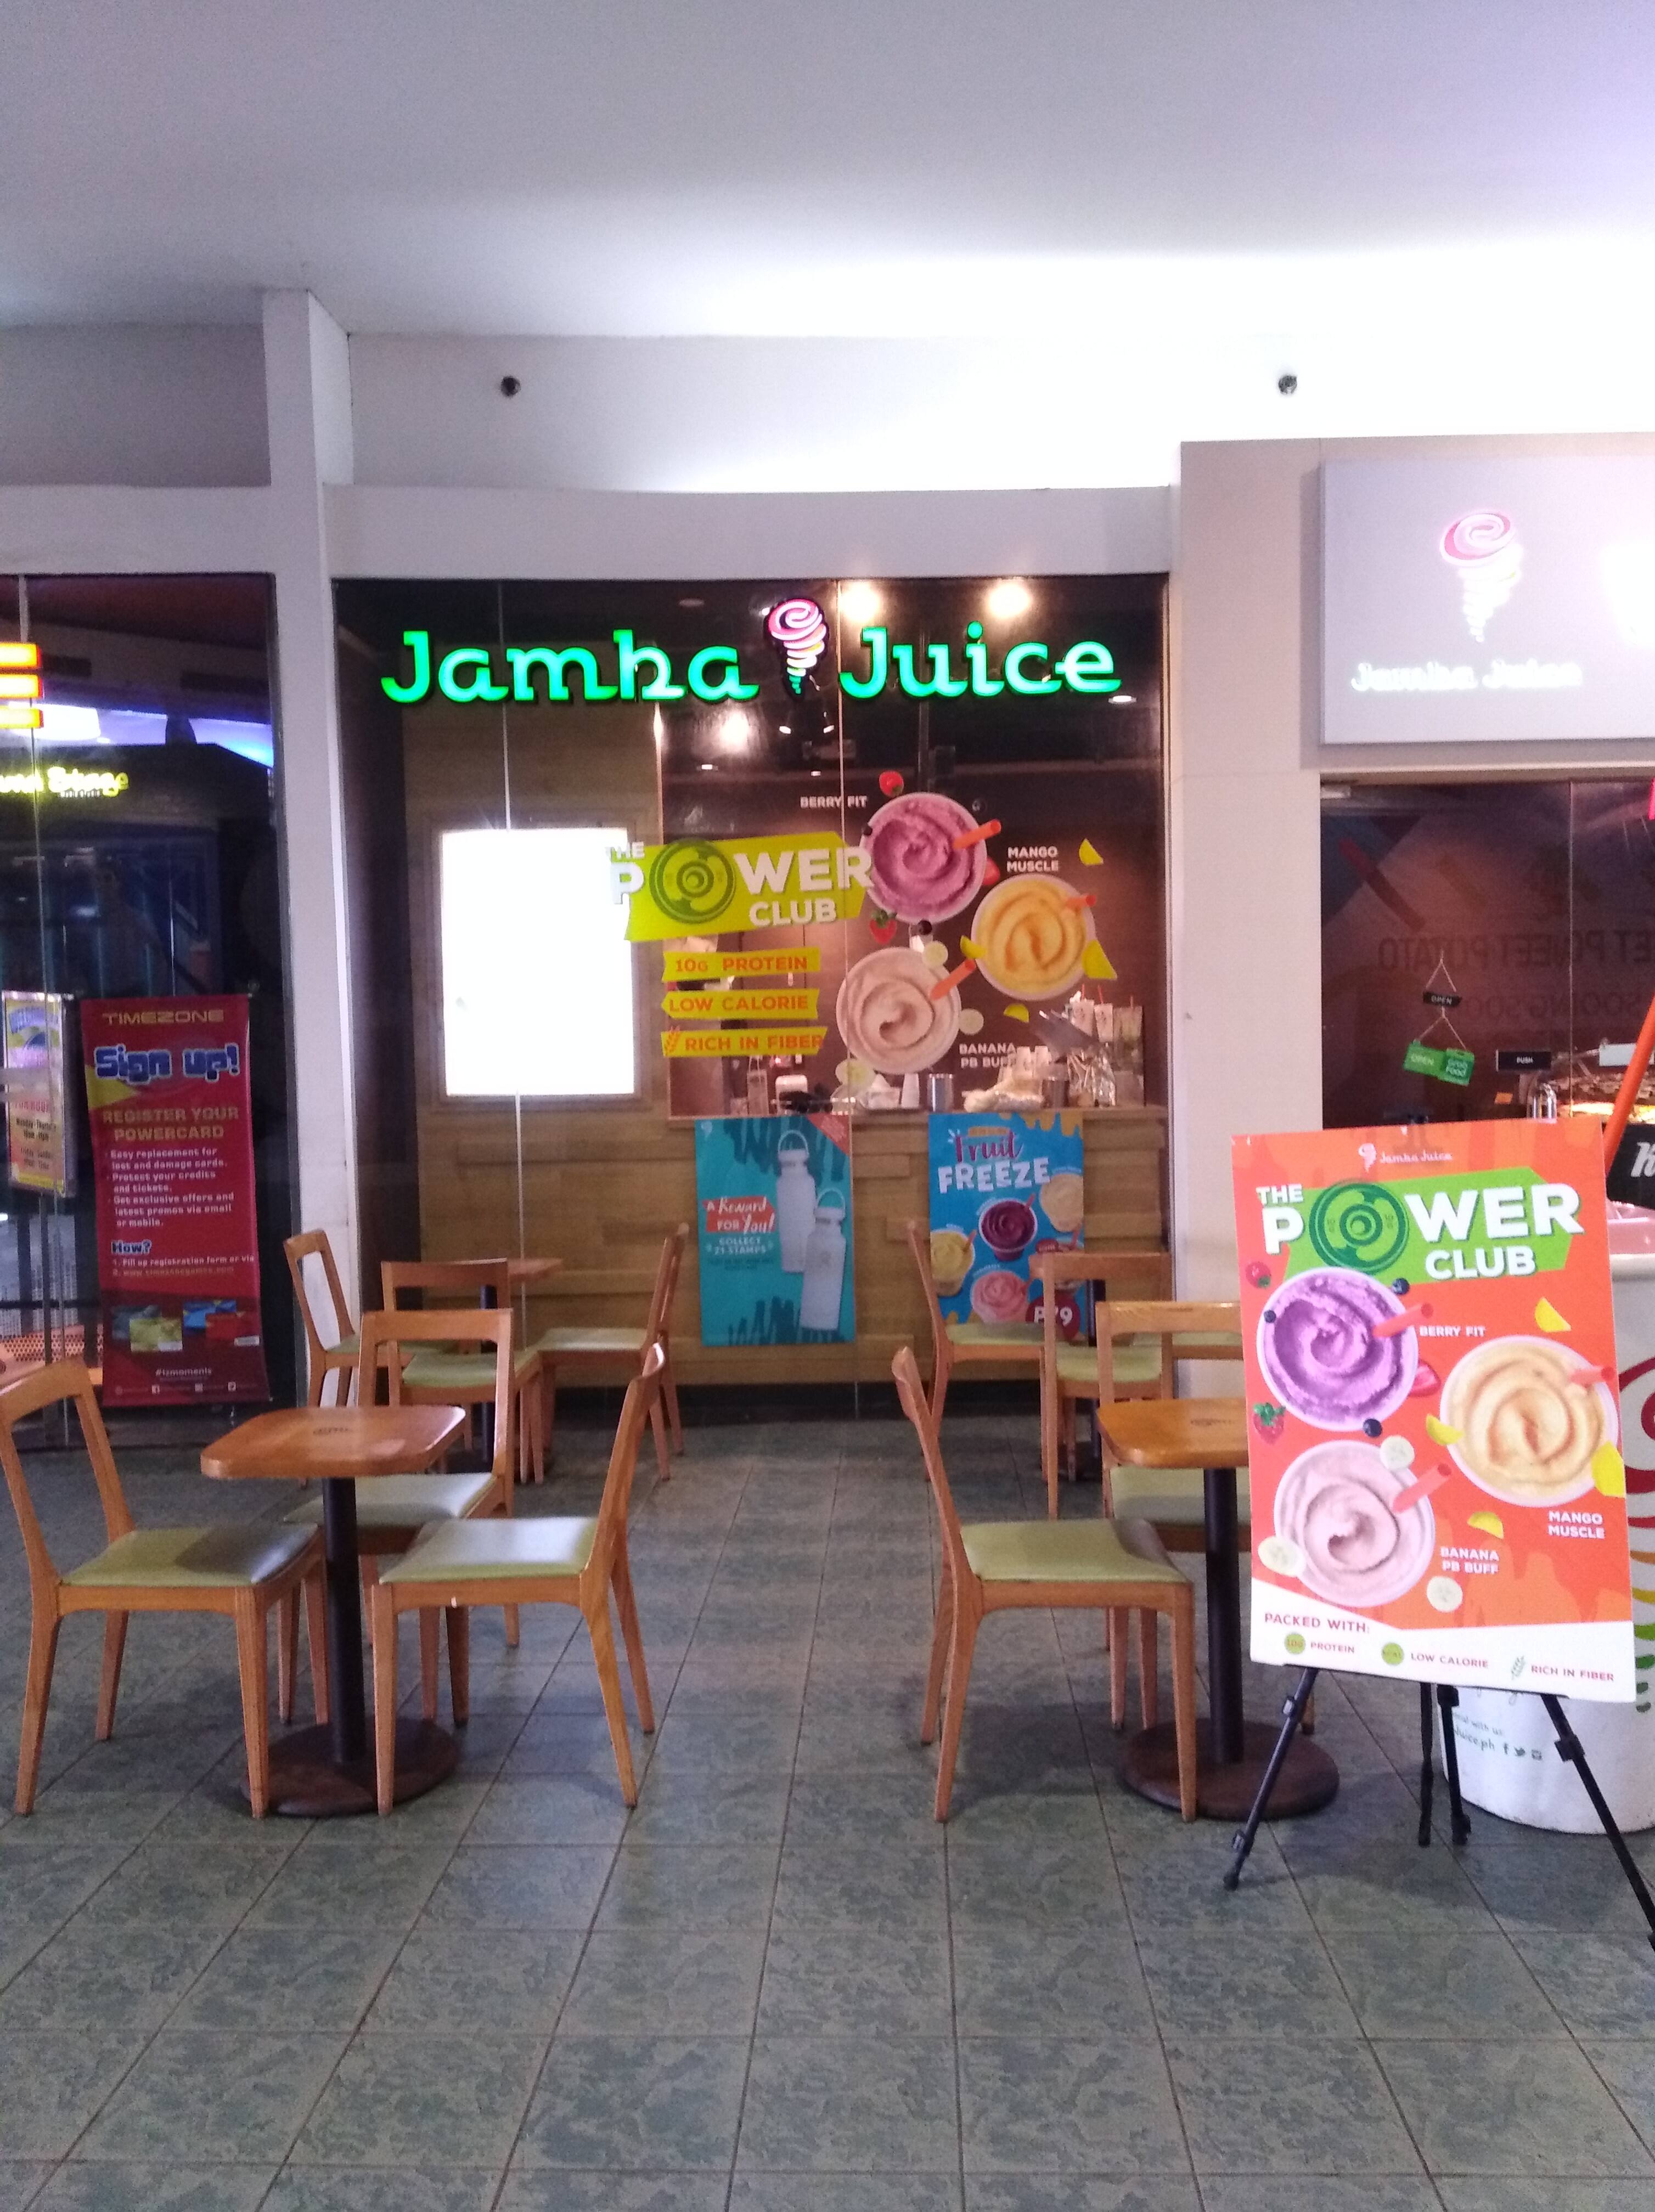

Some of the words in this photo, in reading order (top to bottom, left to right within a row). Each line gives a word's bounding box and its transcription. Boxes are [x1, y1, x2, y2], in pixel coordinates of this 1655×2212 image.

[381, 629, 759, 703] Jamba
[840, 621, 1122, 698] Juice
[800, 796, 842, 809] BERRY
[847, 795, 868, 808] FIT
[605, 841, 645, 860] THE
[1007, 846, 1059, 859] MANGO
[1006, 860, 1059, 873] MUSCLE
[749, 898, 837, 927] CLUB
[722, 957, 808, 970] PROTEIN
[669, 997, 713, 1012] LOW
[722, 995, 808, 1011] CALORIE
[1431, 995, 1453, 1005] OPEN
[103, 1009, 224, 1024] TIMEZONE
[685, 1037, 731, 1051] RICH
[739, 1037, 758, 1049] IN
[767, 1035, 823, 1049] FIBER
[959, 1042, 1017, 1054] BANANA
[94, 1043, 173, 1085] Sign
[182, 1042, 240, 1082] up!
[961, 1057, 978, 1069] PB
[103, 1108, 185, 1123] REGISTER
[192, 1107, 239, 1120] YOUR
[114, 1126, 224, 1141] POWERCARD
[955, 1129, 1024, 1163] Fruit
[111, 1149, 133, 1160] Easy
[137, 1148, 199, 1159] replacement
[202, 1147, 217, 1155] for
[1420, 1150, 1453, 1161] Juice
[112, 1161, 131, 1170] lost
[134, 1161, 151, 1169] and
[154, 1160, 192, 1169] damage
[112, 1172, 150, 1181] Protect
[153, 1172, 176, 1182] your
[178, 1170, 216, 1179] credits
[938, 1156, 1050, 1194] FREEZE
[114, 1184, 130, 1193] and
[1256, 1183, 1304, 1206] THE
[114, 1195, 131, 1204] Get
[133, 1194, 179, 1204] exclusive
[183, 1193, 213, 1203] offers
[216, 1192, 234, 1201] and
[115, 1207, 144, 1216] latest
[147, 1207, 184, 1217] promos
[187, 1205, 201, 1214] via
[204, 1204, 232, 1213] email
[718, 1196, 767, 1215] Reward
[116, 1219, 127, 1227] or
[111, 1239, 153, 1255] How?
[150, 1257, 204, 1267] registration
[1424, 1245, 1537, 1280] CLUB
[1420, 1325, 1461, 1337] BERRY
[1465, 1325, 1486, 1337] FIT
[1549, 1510, 1603, 1525] MANGO
[1548, 1525, 1605, 1539] MUSCLE
[1440, 1547, 1500, 1561] BANANA
[1442, 1560, 1460, 1573] PB
[1464, 1561, 1499, 1575] BUFF
[1264, 1613, 1321, 1628] PACKED
[1327, 1619, 1370, 1634] WITH:
[1310, 1641, 1355, 1653] PROTEIN
[1410, 1652, 1435, 1662] LOW
[1439, 1655, 1489, 1668] CALORIE
[1530, 1664, 1558, 1676] RICH
[1563, 1666, 1575, 1677] IN
[1580, 1668, 1614, 1681] FIBER
